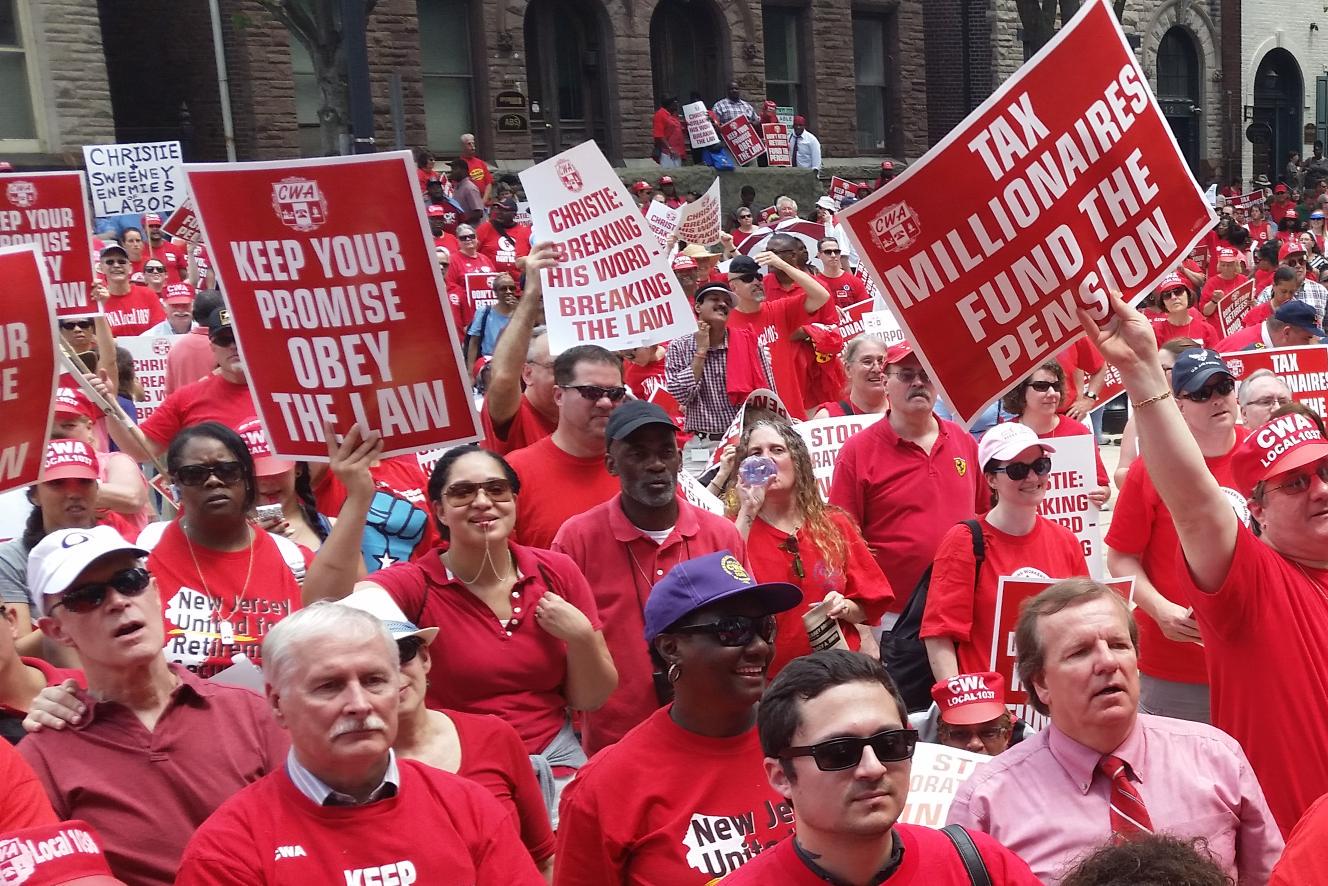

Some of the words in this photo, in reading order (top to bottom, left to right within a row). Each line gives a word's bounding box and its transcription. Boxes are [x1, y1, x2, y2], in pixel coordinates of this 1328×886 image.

[967, 91, 1050, 181] TAX
[90, 143, 180, 167] CHRISTIE
[91, 165, 174, 186] SWEENEY
[96, 180, 175, 200] ENEMIES
[278, 183, 314, 201] CWA
[884, 62, 1149, 309] MILLIONAIRES
[26, 208, 75, 230] YOUR
[103, 194, 176, 214] LABOR
[548, 186, 623, 234] CHRISTIE:
[875, 202, 906, 235] CWA
[556, 214, 643, 263] BREAKING
[650, 214, 677, 231] CHRIST
[230, 239, 305, 281] KEEP
[310, 231, 405, 279] YOUR
[955, 224, 1085, 344] FUND
[1078, 147, 1160, 243] THE
[548, 264, 590, 288] HIS
[592, 243, 651, 283] WORD
[55, 281, 88, 309] AW
[254, 281, 406, 330] PROMISE
[559, 272, 672, 317] BREAKING
[987, 206, 1178, 382] PENSION
[572, 316, 619, 342] THE
[626, 302, 675, 329] LAW
[287, 330, 393, 389] OBEY
[1270, 353, 1299, 373] TAX
[271, 392, 343, 443] THE
[349, 379, 450, 442] LAW
[1299, 397, 1328, 419] THE
[1256, 412, 1312, 450] CWA
[1260, 438, 1301, 468] LOCAL
[1036, 493, 1089, 516] AKING
[178, 591, 222, 611] New
[232, 596, 291, 617] Jersey
[947, 690, 978, 706] LOCAL
[692, 812, 754, 847] New
[26, 830, 75, 865] Local
[343, 860, 417, 886] KEEP
